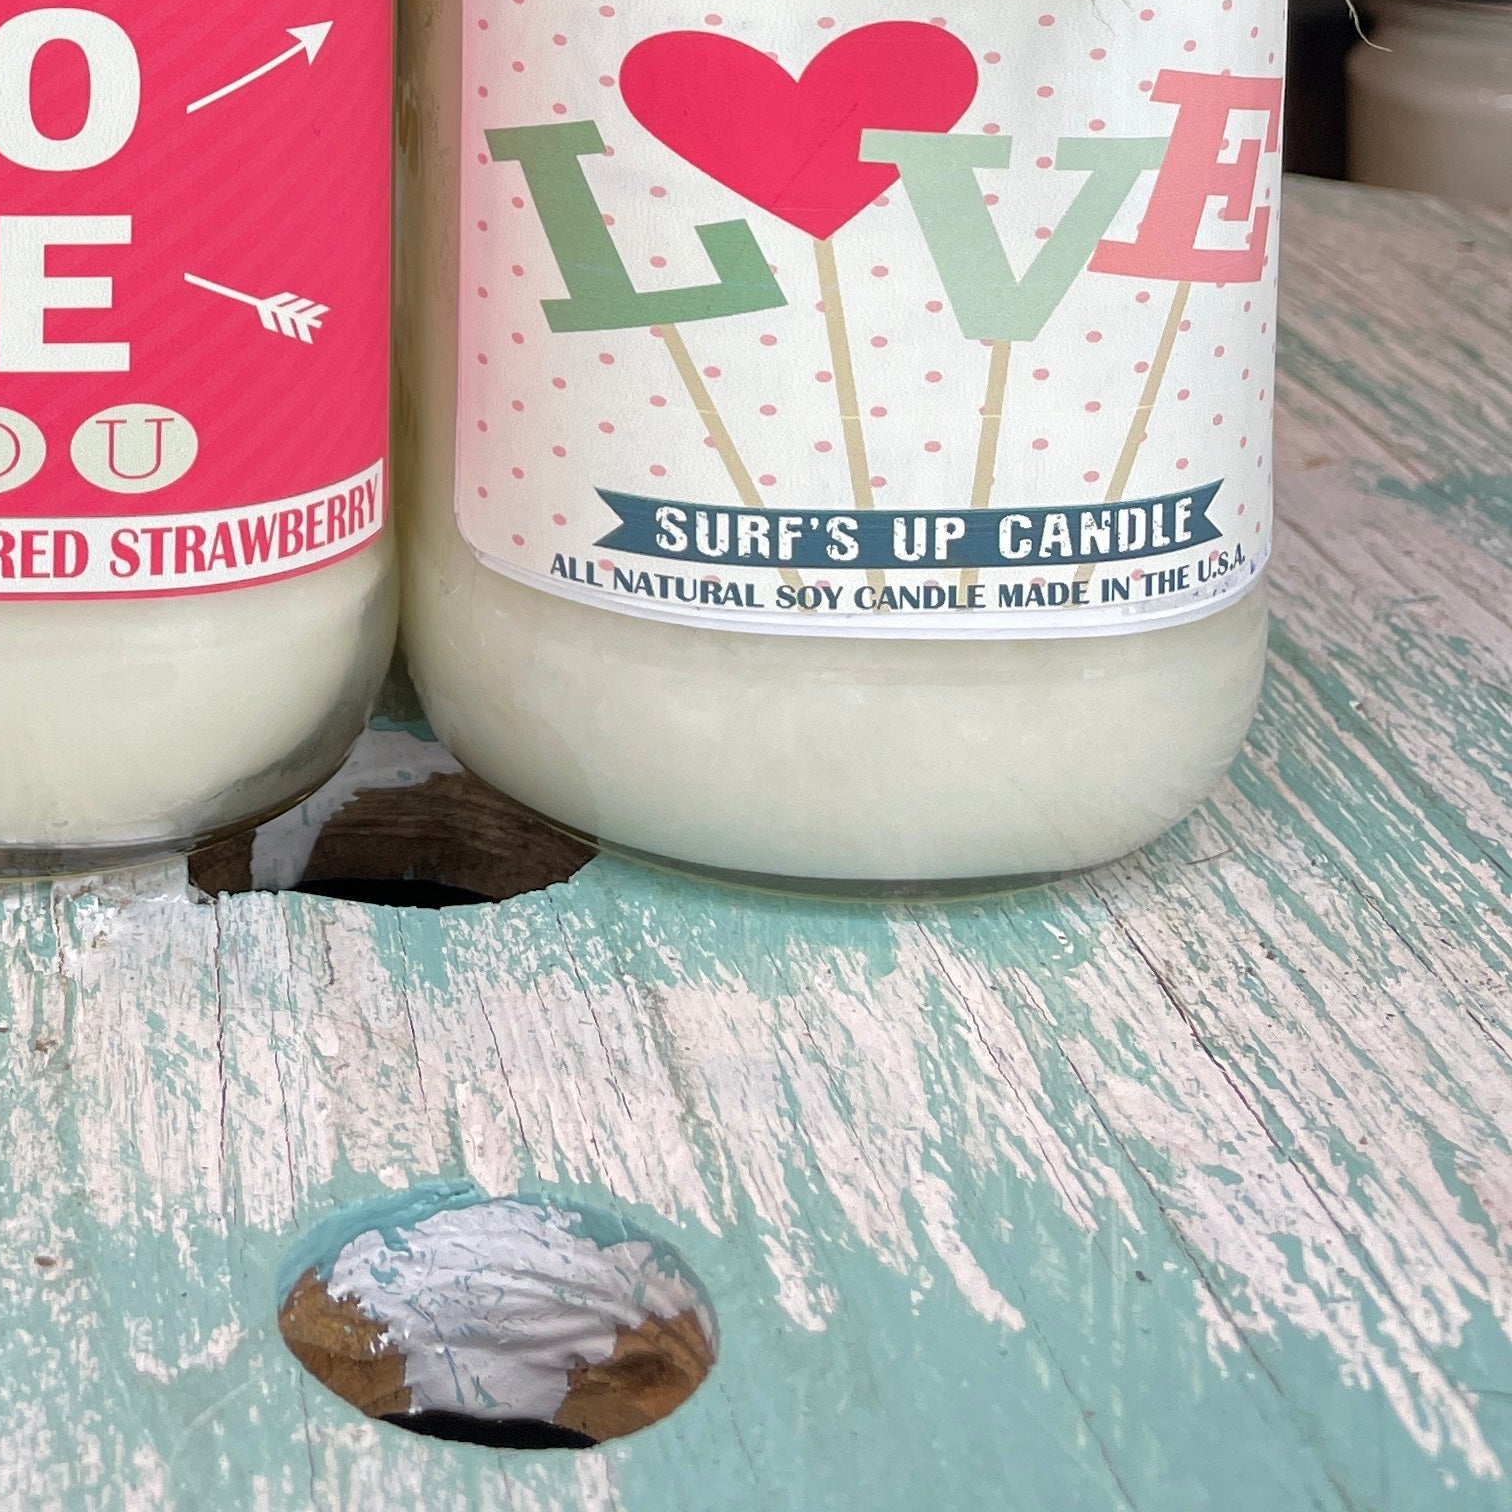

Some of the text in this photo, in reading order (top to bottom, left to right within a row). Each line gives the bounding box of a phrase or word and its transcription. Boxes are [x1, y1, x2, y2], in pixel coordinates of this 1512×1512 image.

[109, 474, 383, 580] STRAWBERRY
[655, 496, 1193, 562] SURF'S UP CANDLE
[549, 551, 605, 589] ALL
[612, 566, 765, 609] NATURAL
[775, 582, 841, 612] SOY
[854, 582, 987, 612] CANDLE
[997, 579, 1090, 609] MADE
[1101, 576, 1130, 603] IN
[1140, 564, 1190, 597] THE
